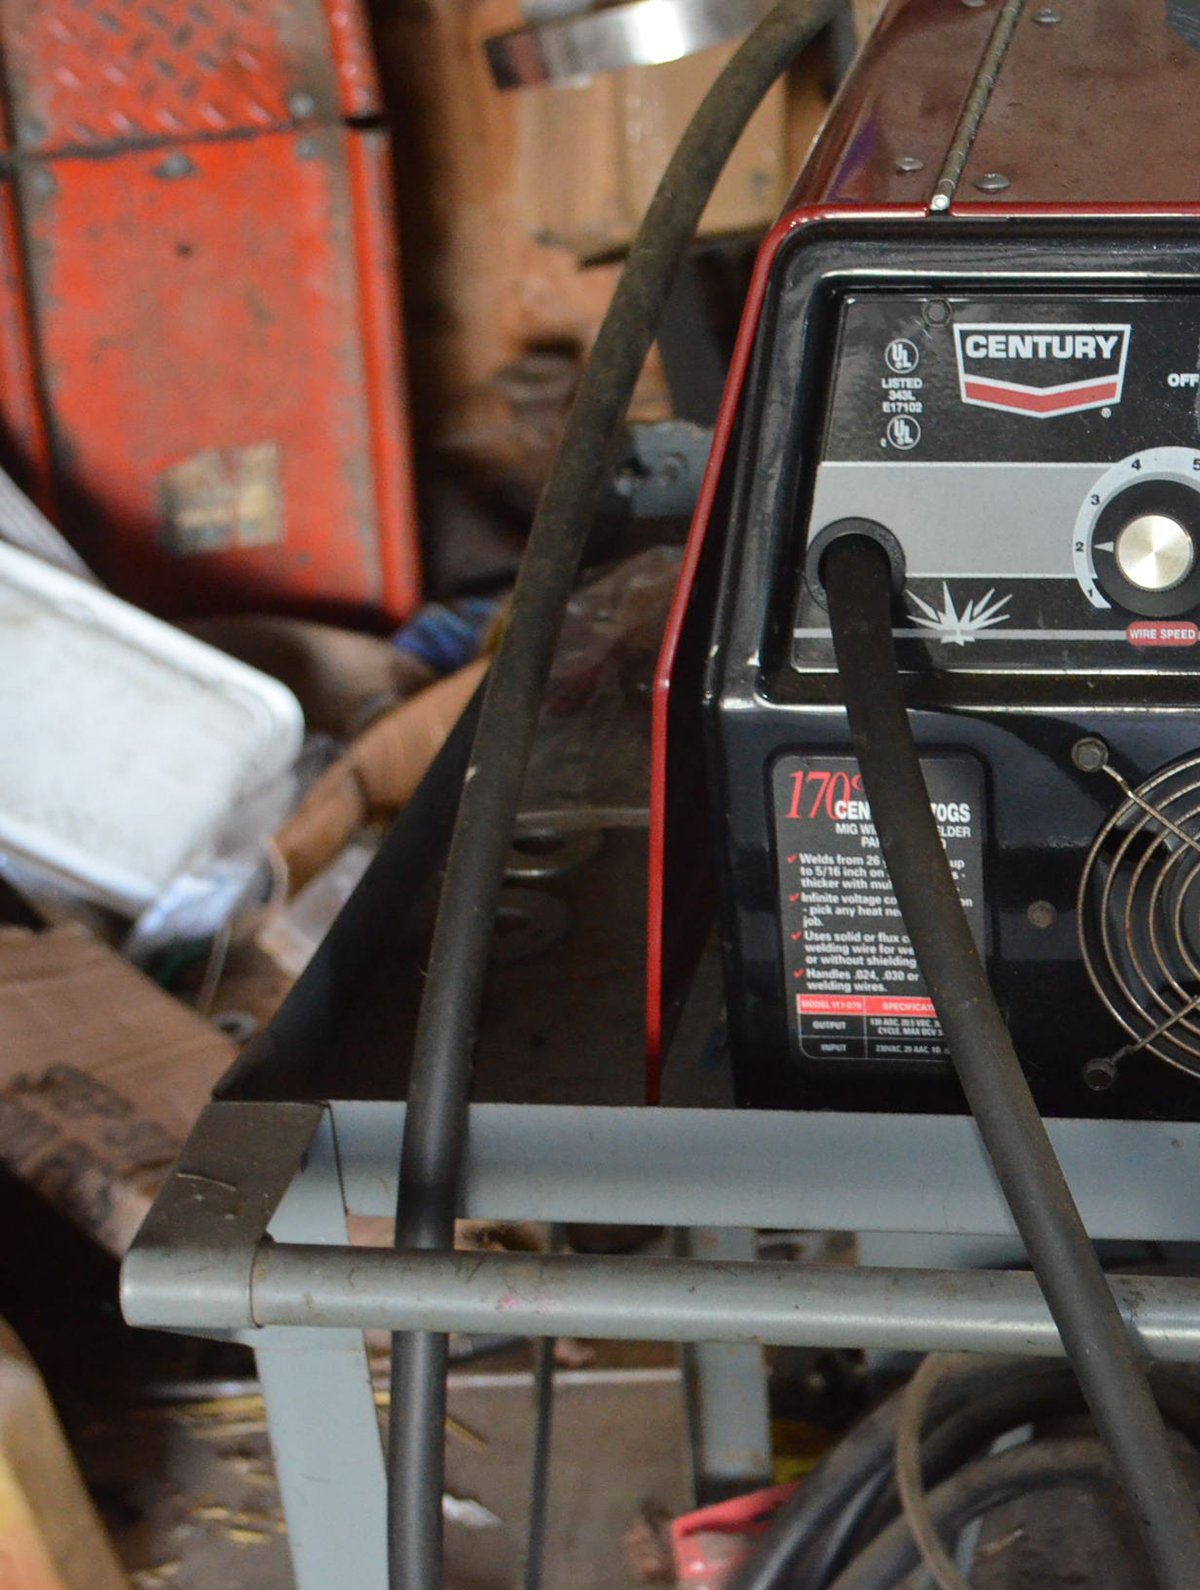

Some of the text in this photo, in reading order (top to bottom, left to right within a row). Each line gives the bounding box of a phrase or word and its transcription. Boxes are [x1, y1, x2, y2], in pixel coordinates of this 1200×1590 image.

[965, 334, 1118, 359] CENTURY
[881, 377, 923, 389] LISTED
[1167, 373, 1200, 387] OFF
[1131, 458, 1141, 470] 4
[1091, 494, 1100, 506] 3
[1075, 541, 1084, 552] 2
[1087, 588, 1093, 598] 1
[1130, 628, 1196, 640] WIRE SPEED
[930, 802, 971, 823] 0GS
[835, 823, 971, 838] MIG WI LDER
[799, 853, 834, 865] Welds
[836, 853, 864, 865] from
[866, 855, 880, 866] 26
[800, 865, 813, 876] to
[815, 866, 840, 877] 5/16
[843, 867, 867, 877] inch
[869, 869, 884, 878] on
[801, 878, 839, 888] thicker
[841, 879, 868, 889] with
[801, 892, 840, 903] Infinite
[841, 893, 881, 906] voltage
[809, 905, 833, 916] pick
[835, 907, 856, 918] any
[857, 905, 883, 916] heat
[802, 916, 824, 928] job.
[803, 930, 832, 942] Uses
[833, 931, 861, 942] solid
[863, 933, 875, 942] or
[878, 931, 900, 943] flux
[804, 943, 849, 955] welding
[851, 944, 877, 954] wire
[879, 944, 895, 954] for
[805, 955, 917, 969] or without shielding
[805, 968, 851, 979] Handles
[907, 972, 920, 981] or
[806, 981, 888, 993] welding wires.
[801, 1000, 830, 1009] MODEL
[812, 1020, 846, 1030] OUTPUT
[820, 1043, 847, 1053] INPUT
